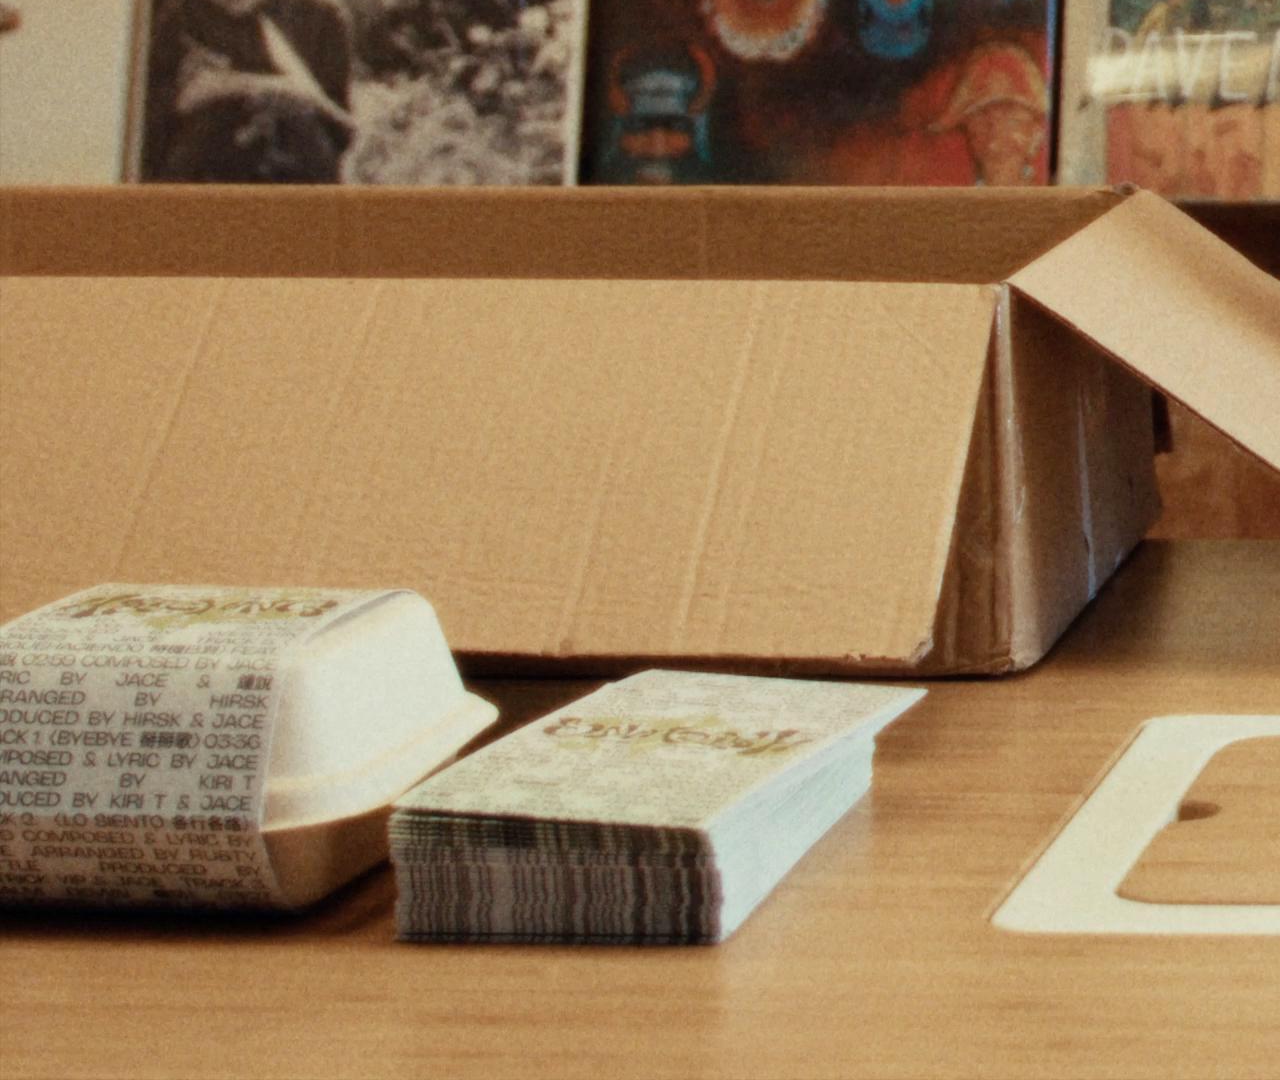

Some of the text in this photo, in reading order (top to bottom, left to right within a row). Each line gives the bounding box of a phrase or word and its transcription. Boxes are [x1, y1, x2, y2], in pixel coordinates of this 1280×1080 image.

[59, 671, 89, 686] BY
[115, 672, 169, 688] JACE
[196, 674, 211, 689] &
[134, 691, 162, 707] BY
[209, 694, 270, 709] HIRSK
[87, 710, 116, 726] BY
[122, 712, 182, 727] HIRSK
[189, 712, 205, 728] &
[211, 713, 266, 729] JACE
[83, 751, 97, 768] &
[107, 751, 160, 768] LYRIC
[170, 753, 199, 769] BY
[206, 754, 258, 771] JACE
[119, 772, 146, 788] BY
[199, 774, 234, 790] KIRI
[244, 775, 257, 791] T
[72, 791, 98, 808] BY
[109, 792, 145, 809] KIRI
[154, 793, 168, 809] T
[176, 794, 191, 810] &
[200, 794, 253, 812] JACE
[94, 813, 165, 829] SIENTO
[22, 829, 136, 845] COMPOSED
[165, 832, 219, 846] LYRIC
[226, 834, 256, 848] BY
[30, 845, 146, 860] ARRANGED
[153, 847, 179, 860] BY
[235, 864, 262, 878] BY
